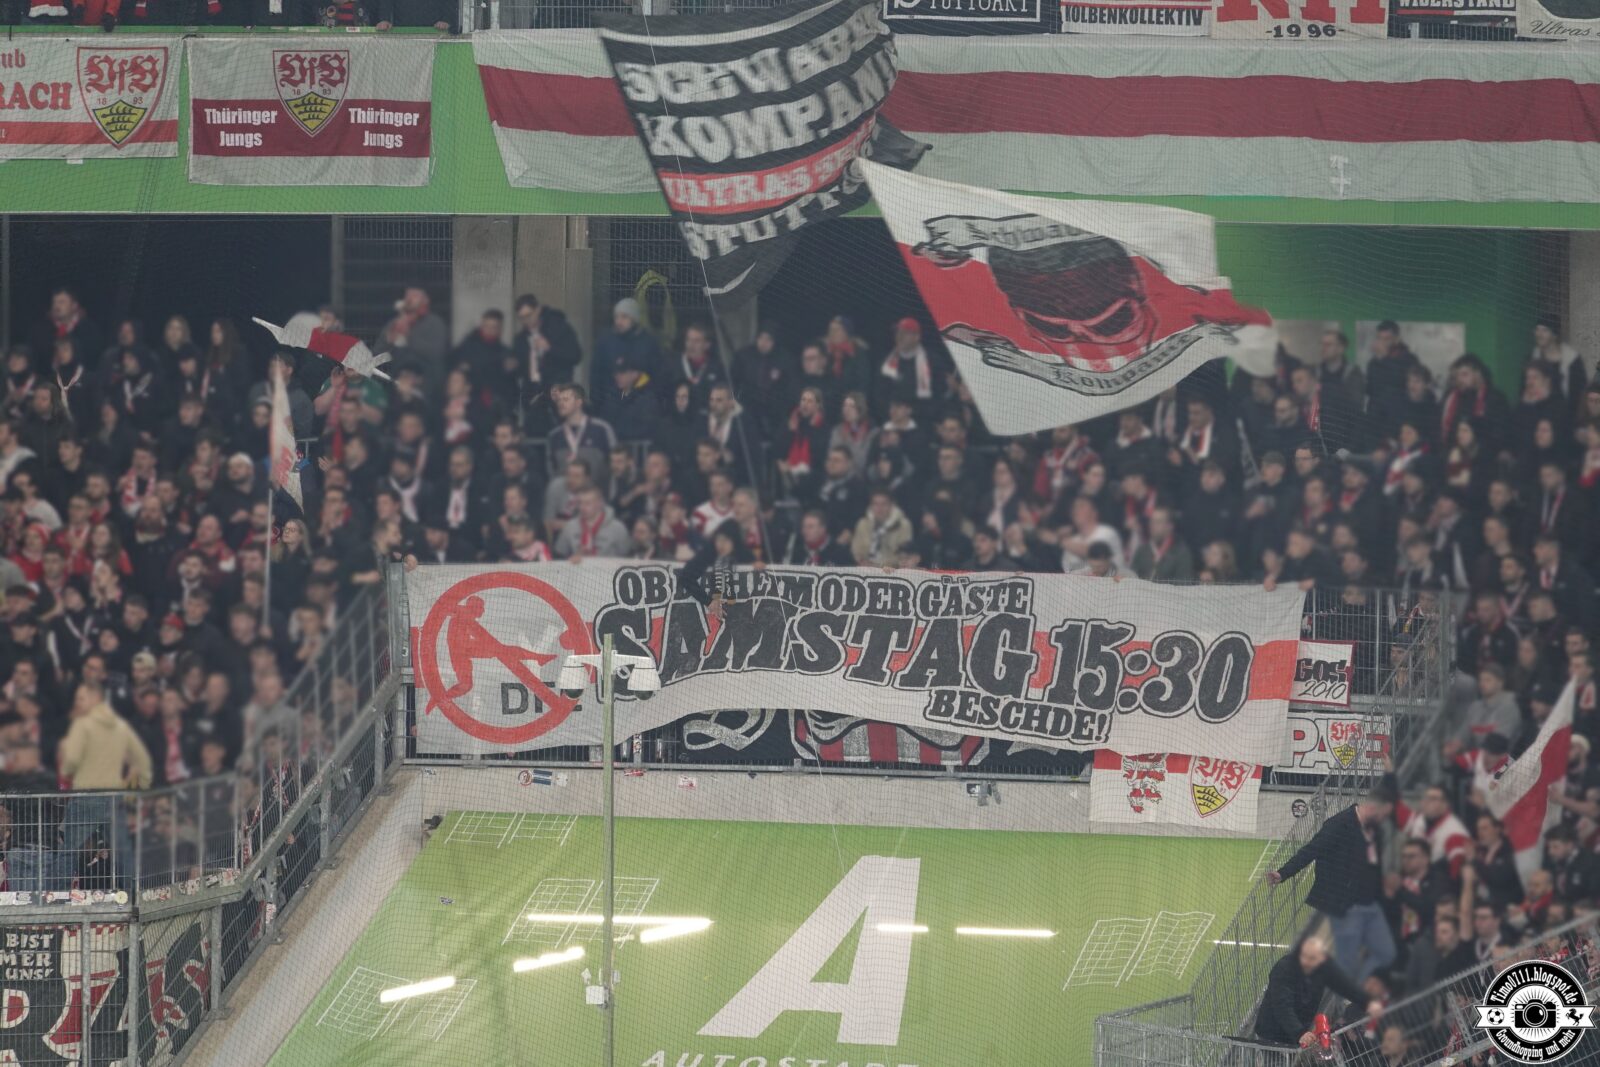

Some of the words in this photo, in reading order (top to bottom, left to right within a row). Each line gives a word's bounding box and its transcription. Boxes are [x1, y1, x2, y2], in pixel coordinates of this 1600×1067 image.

[1064, 5, 1204, 26] KOLBENKOLLEKTIV
[1530, 19, 1592, 36] Ultras
[204, 107, 278, 126] Thüringer
[348, 107, 419, 127] Thüringer
[219, 130, 263, 148] Jungs
[363, 130, 403, 149] Jungs
[616, 568, 674, 607] OB
[819, 575, 914, 617] ODER
[918, 576, 1031, 618] GÄSTE
[595, 600, 1037, 701] SAMSTAG
[1045, 618, 1255, 723] 15:30
[1297, 680, 1348, 700] 2010
[925, 688, 1113, 744] BESCHDE!
[6, 933, 54, 949] BIST
